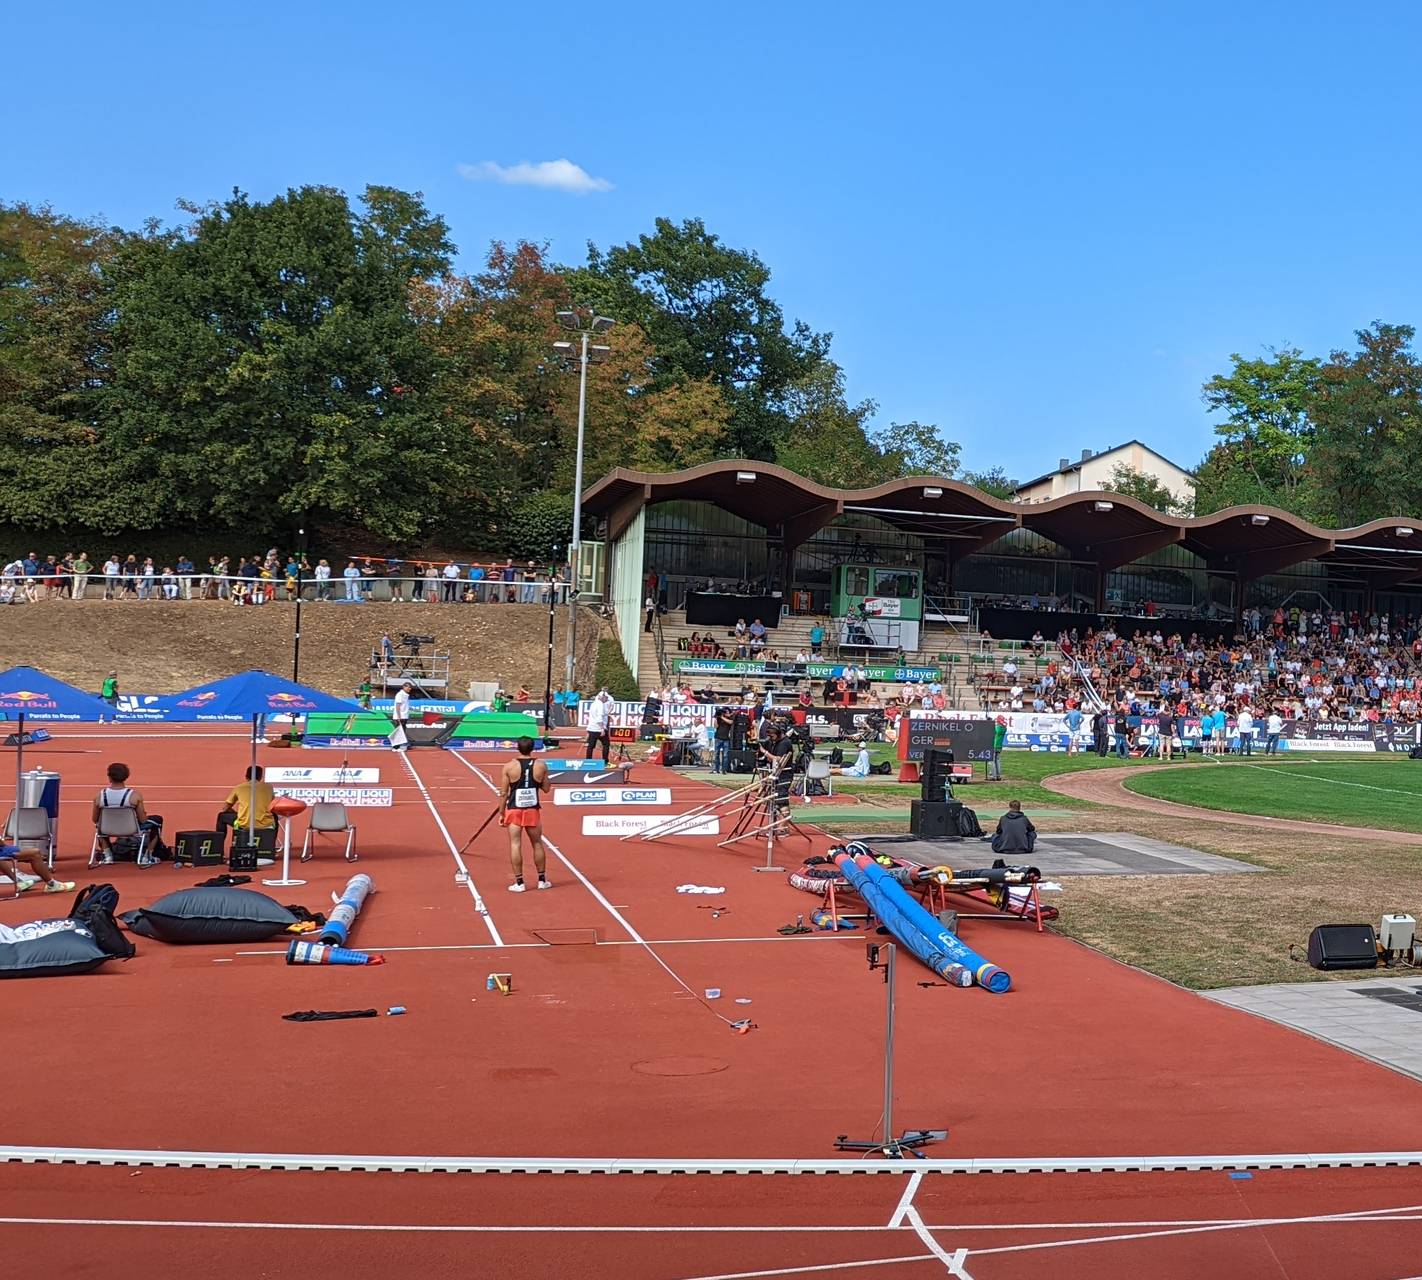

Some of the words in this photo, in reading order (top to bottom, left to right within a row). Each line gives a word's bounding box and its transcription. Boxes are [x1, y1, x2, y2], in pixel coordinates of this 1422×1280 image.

[807, 666, 834, 677] ayer
[906, 670, 938, 680] Bayer
[27, 700, 57, 708] Bull
[671, 704, 705, 716] LIQUI
[806, 715, 829, 724] GLS.
[911, 722, 962, 731] ZERNIKEL
[964, 723, 974, 732] O
[1313, 722, 1333, 730] Jetzt
[1333, 723, 1347, 732] App
[1348, 722, 1369, 731] laden!
[911, 736, 934, 745] GER
[967, 749, 991, 759] 5.43
[361, 790, 390, 798] LIQUI
[361, 798, 390, 806] MOLY
[595, 820, 619, 828] Black
[621, 820, 648, 828] Forest
